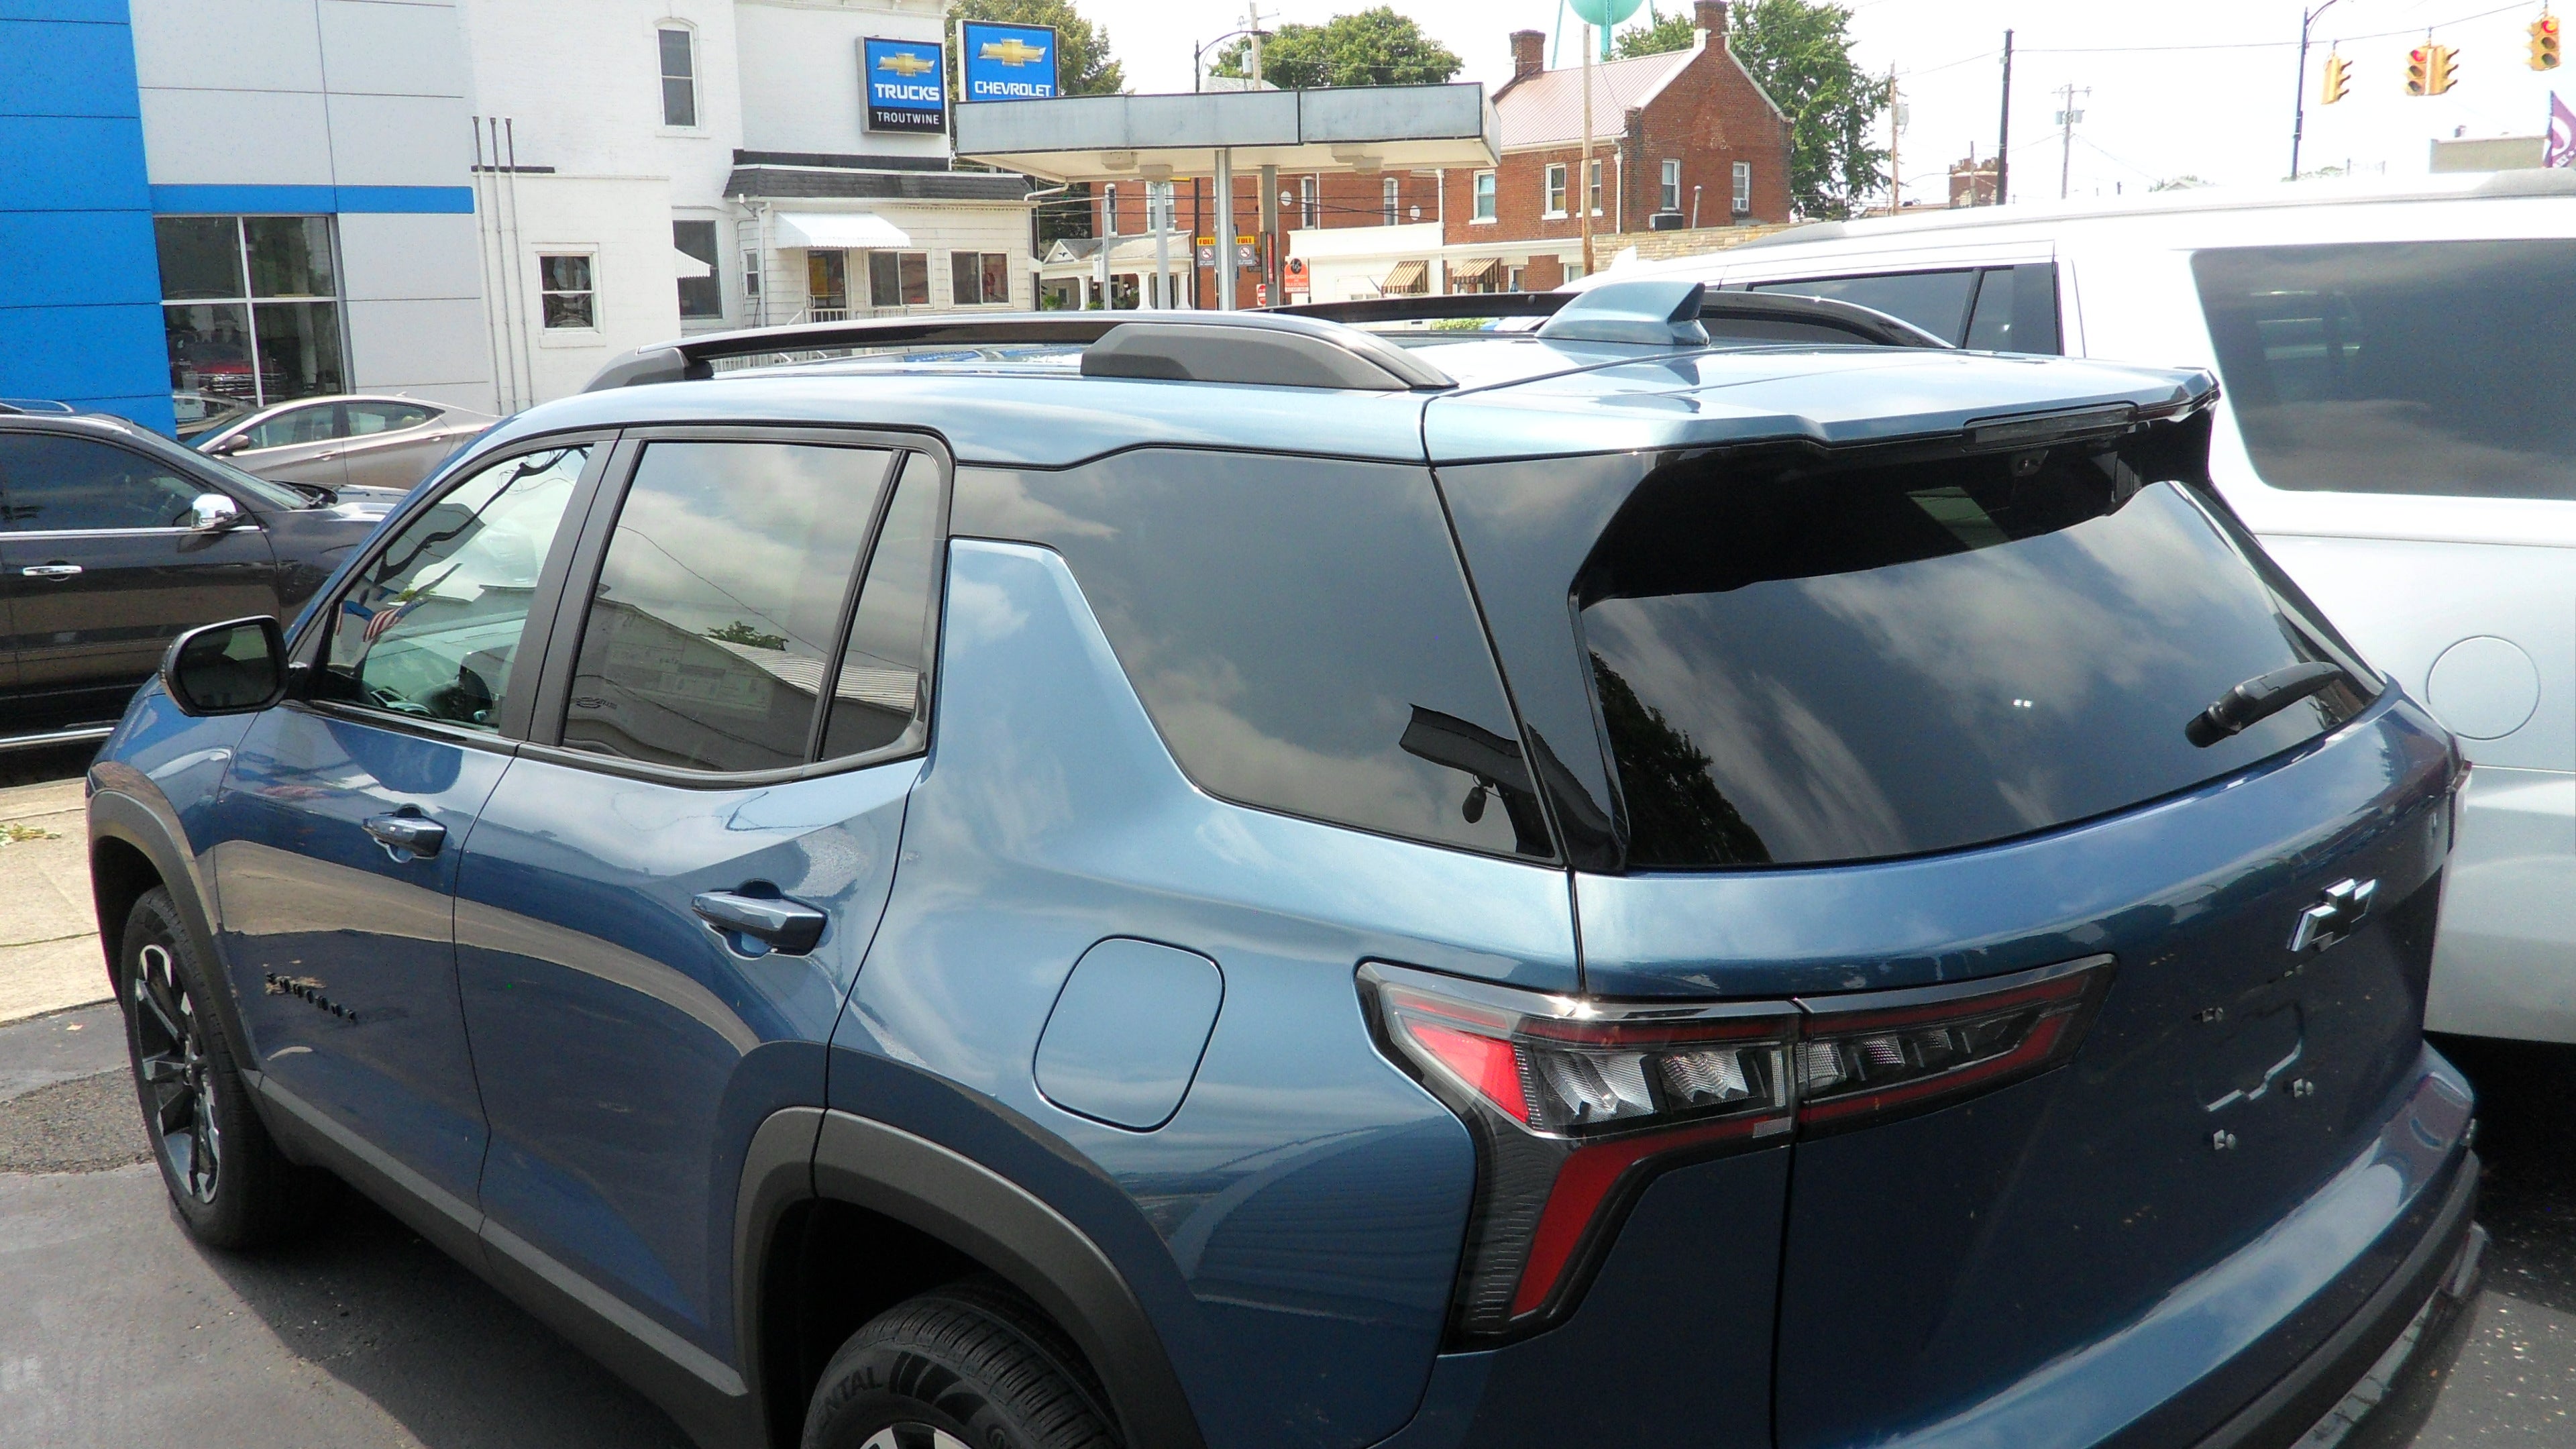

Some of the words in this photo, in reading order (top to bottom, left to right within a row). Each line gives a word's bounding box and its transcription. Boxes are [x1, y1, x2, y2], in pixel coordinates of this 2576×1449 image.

[874, 83, 940, 101] TRUCKS
[975, 80, 1051, 97] CHEVROLET
[877, 111, 940, 125] TROUTWINE
